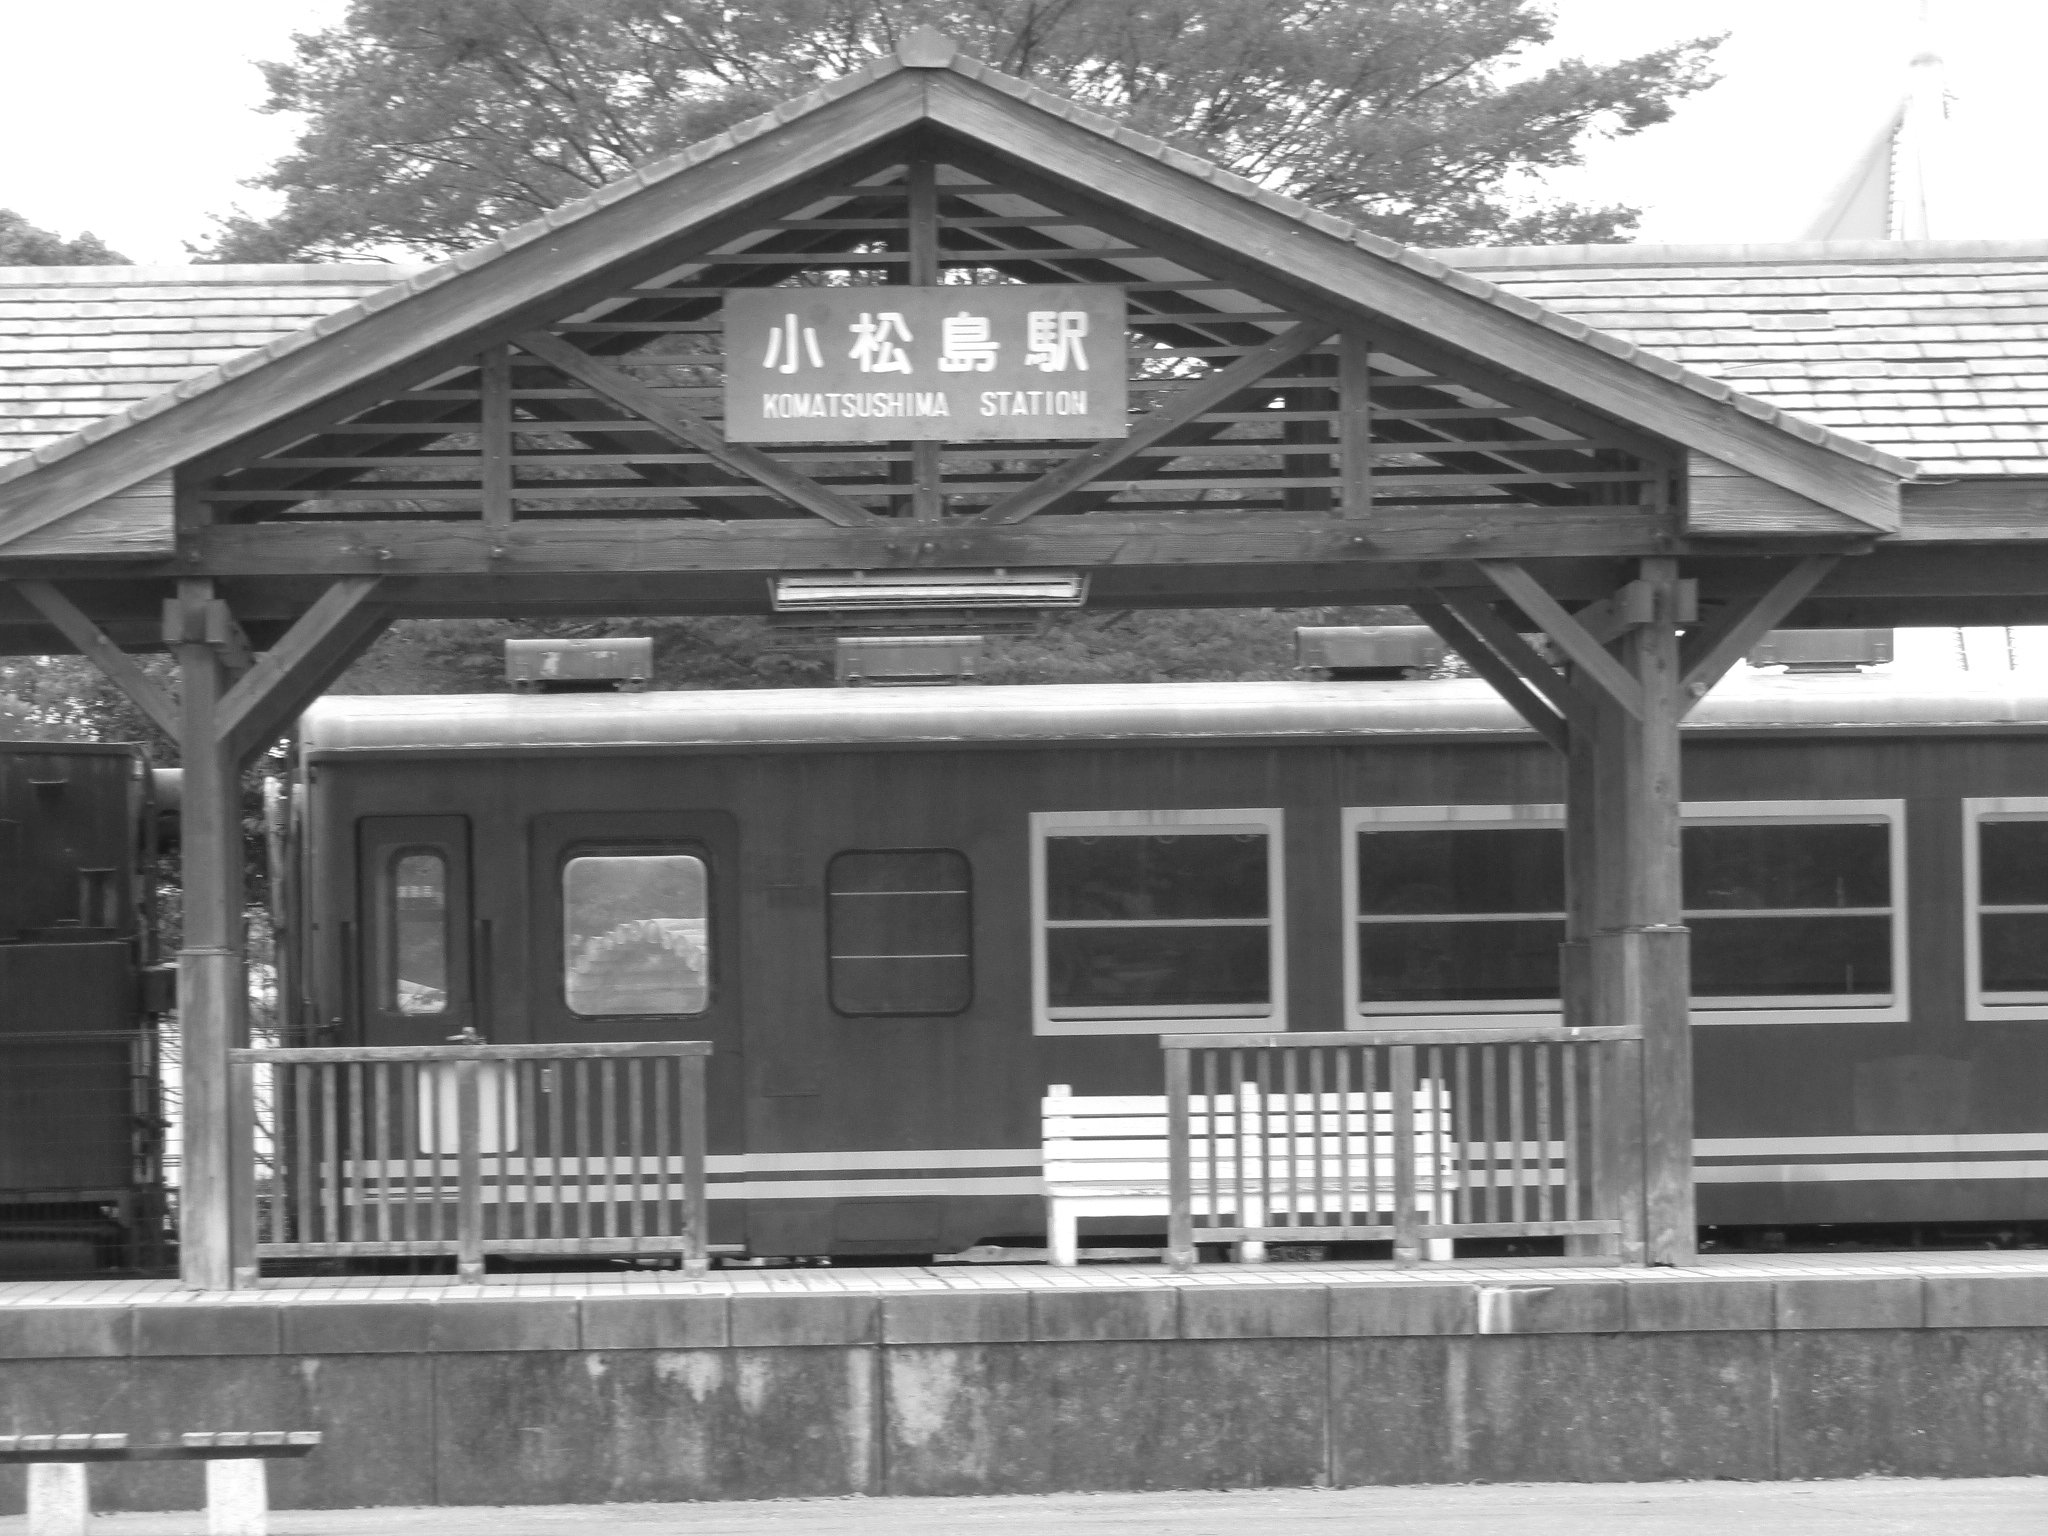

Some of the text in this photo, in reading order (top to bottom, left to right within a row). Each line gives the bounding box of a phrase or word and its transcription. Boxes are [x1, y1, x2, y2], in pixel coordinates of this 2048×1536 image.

[762, 311, 1090, 374] 小松島駅
[763, 390, 1088, 418] KOMATSUSHIMA STATION
